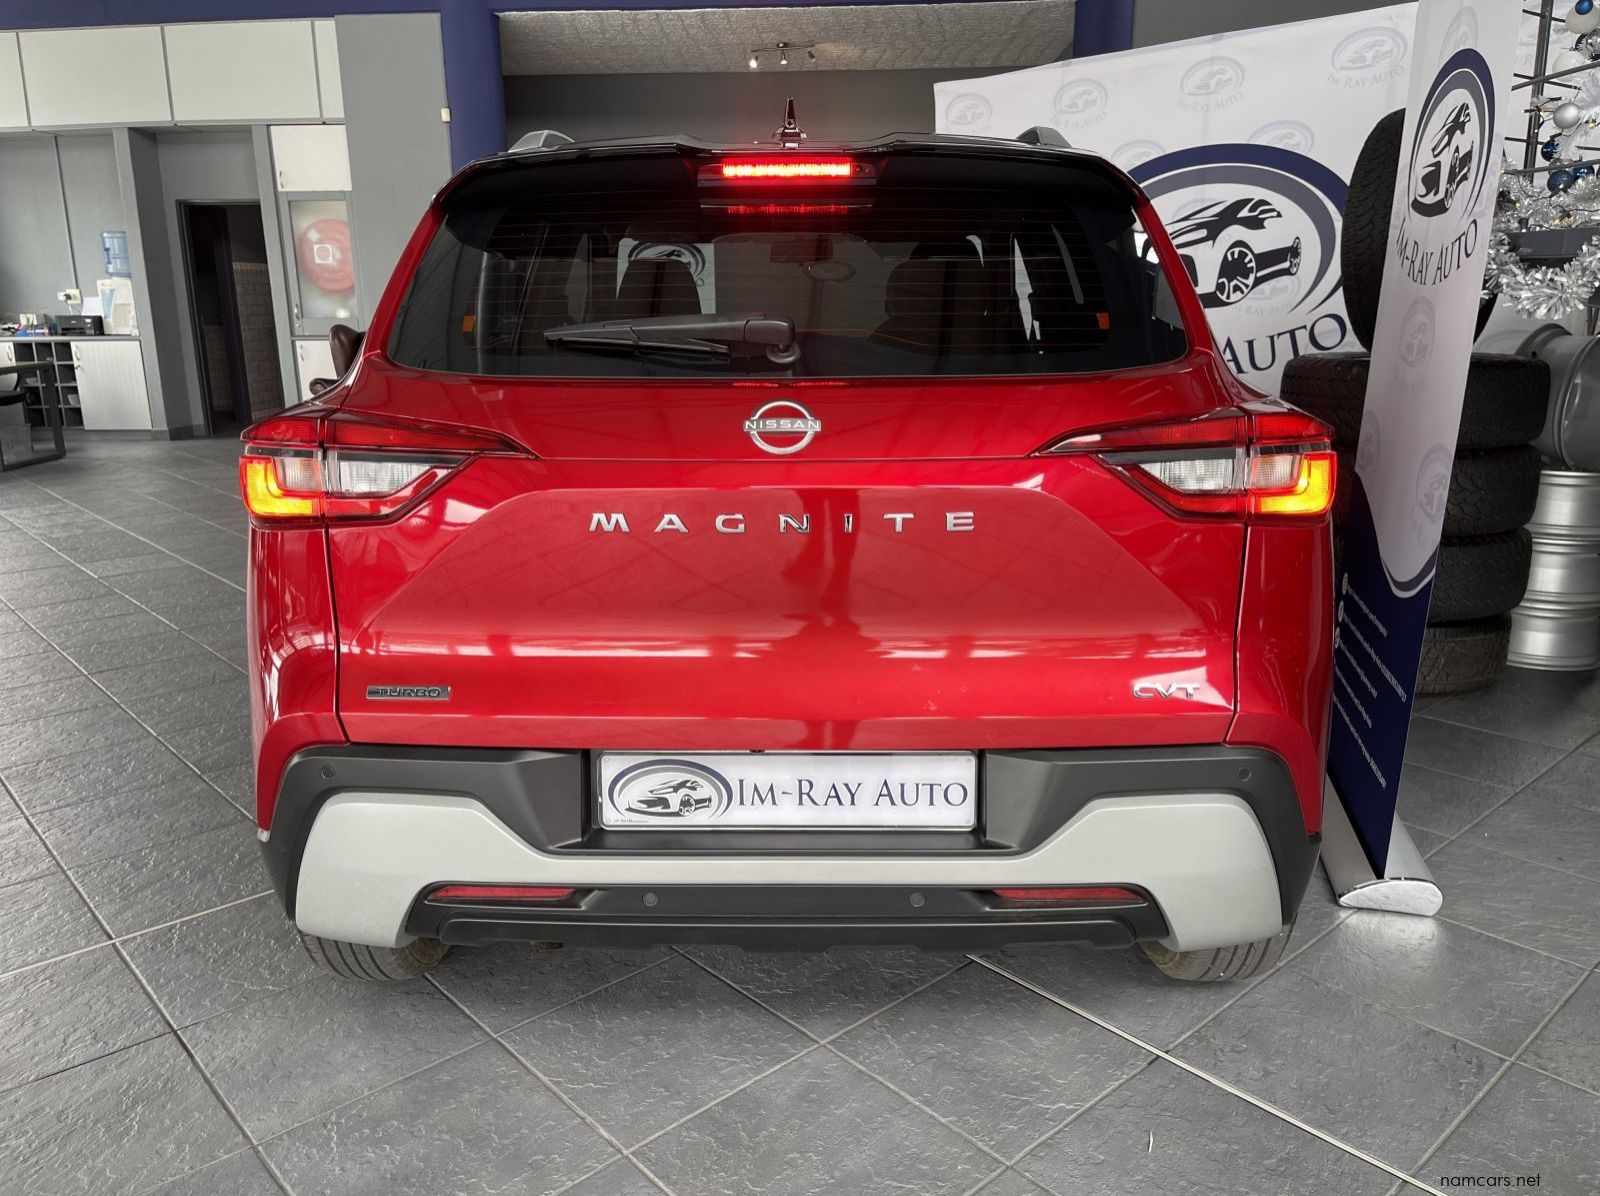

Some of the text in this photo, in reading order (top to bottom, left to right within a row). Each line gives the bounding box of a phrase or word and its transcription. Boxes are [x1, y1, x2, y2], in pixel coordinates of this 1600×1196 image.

[1396, 217, 1477, 285] IM-RAY AUTO
[1222, 313, 1347, 374] AUTO
[745, 418, 820, 431] NISSAN
[588, 511, 975, 534] MAGNITE
[374, 685, 443, 698] TURBO
[1133, 682, 1201, 699] CVT
[873, 778, 969, 807] AUTO
